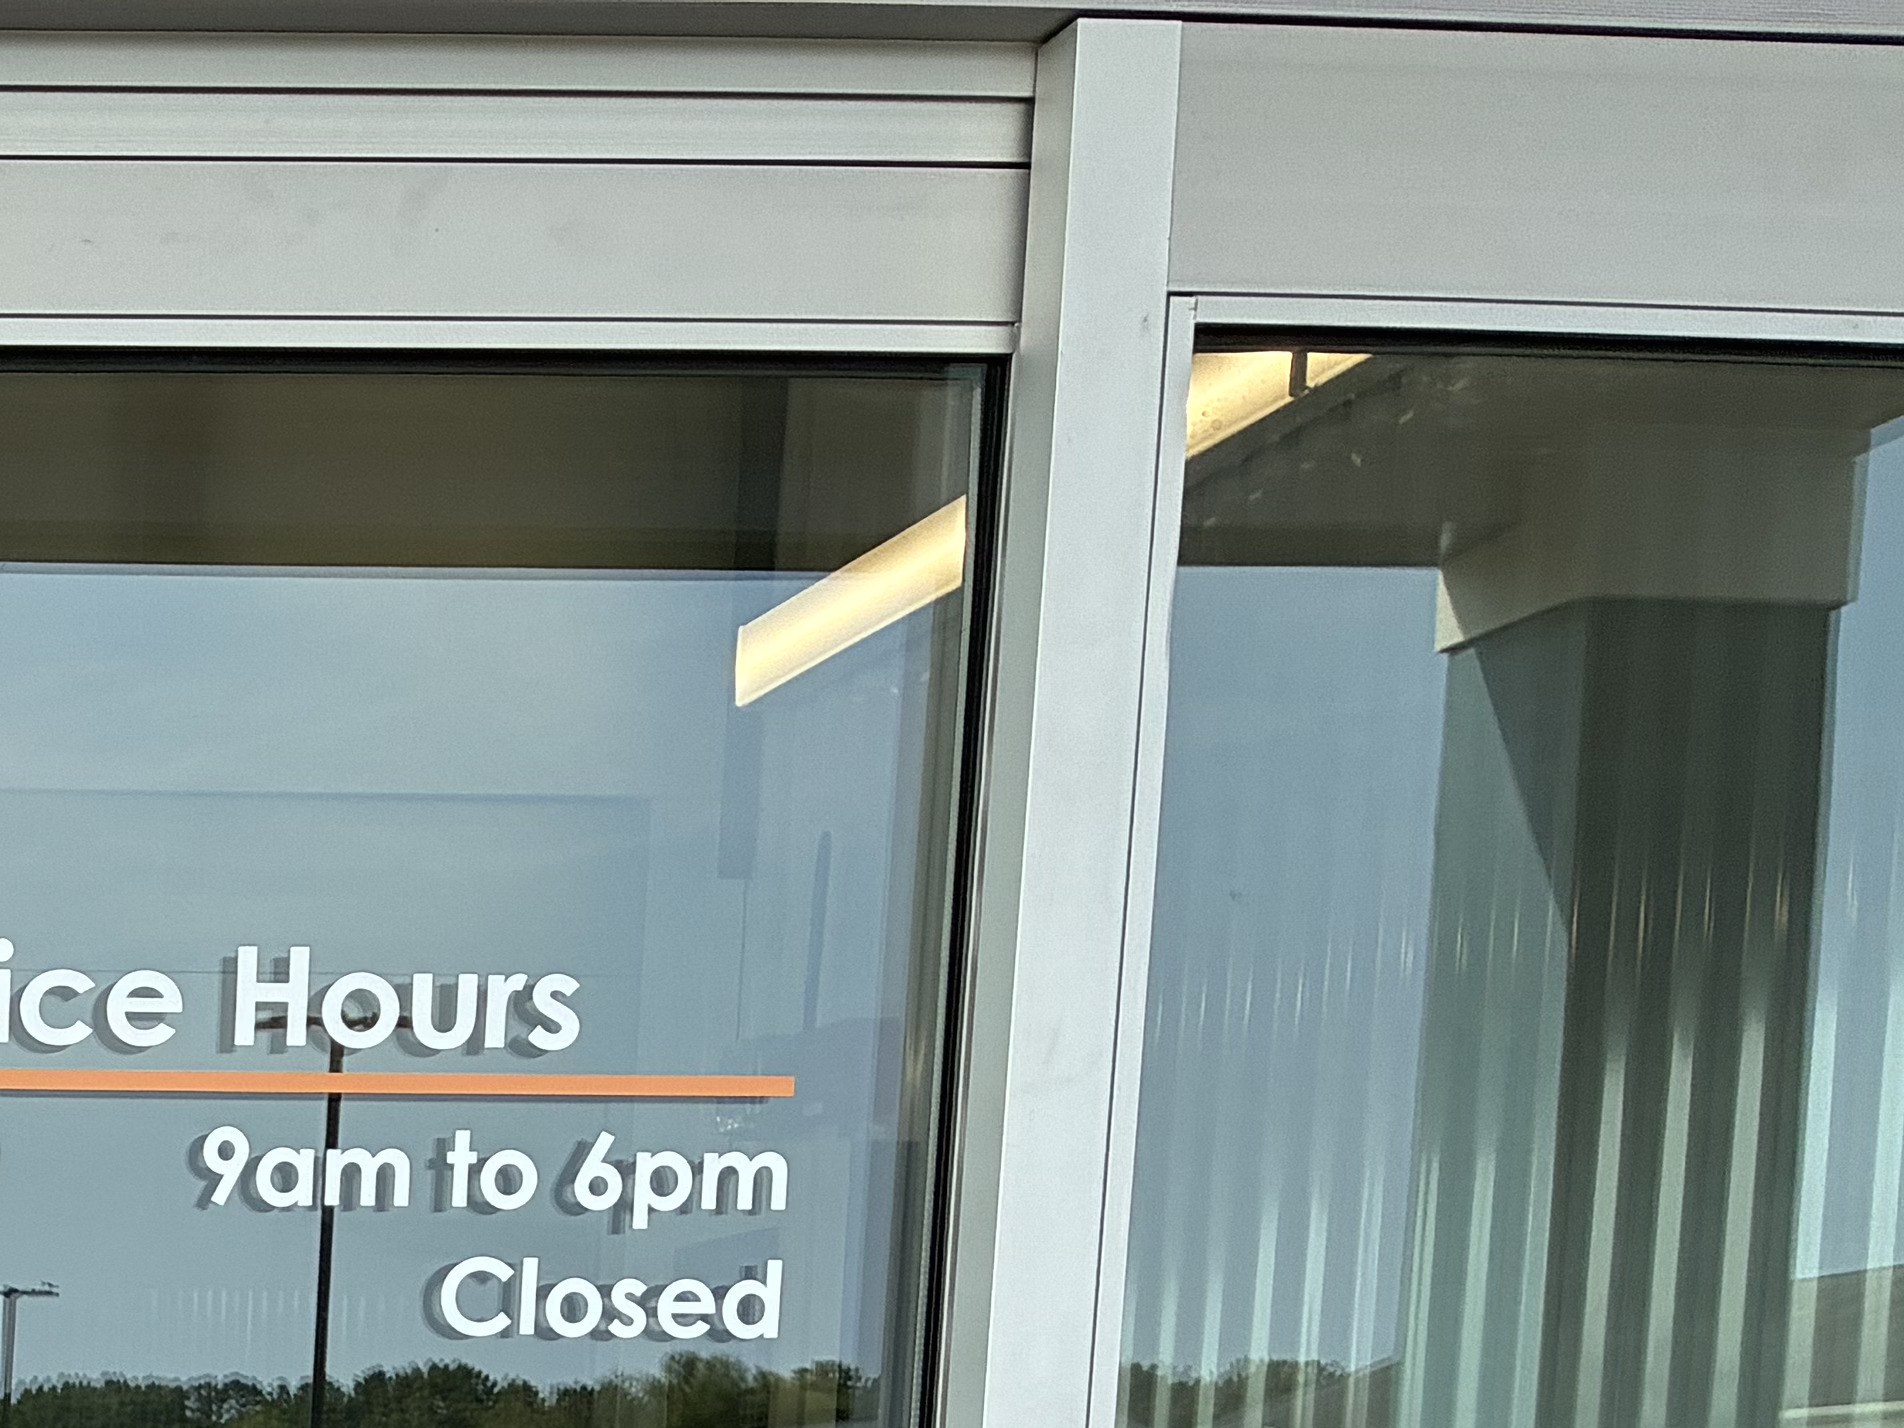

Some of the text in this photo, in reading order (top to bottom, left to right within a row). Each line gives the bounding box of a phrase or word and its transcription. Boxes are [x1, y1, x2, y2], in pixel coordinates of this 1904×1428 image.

[234, 945, 581, 1051] Hours
[203, 1125, 411, 1208] 9am
[446, 1129, 538, 1210] to
[573, 1130, 788, 1230] 6pm
[440, 1256, 783, 1340] Closed
